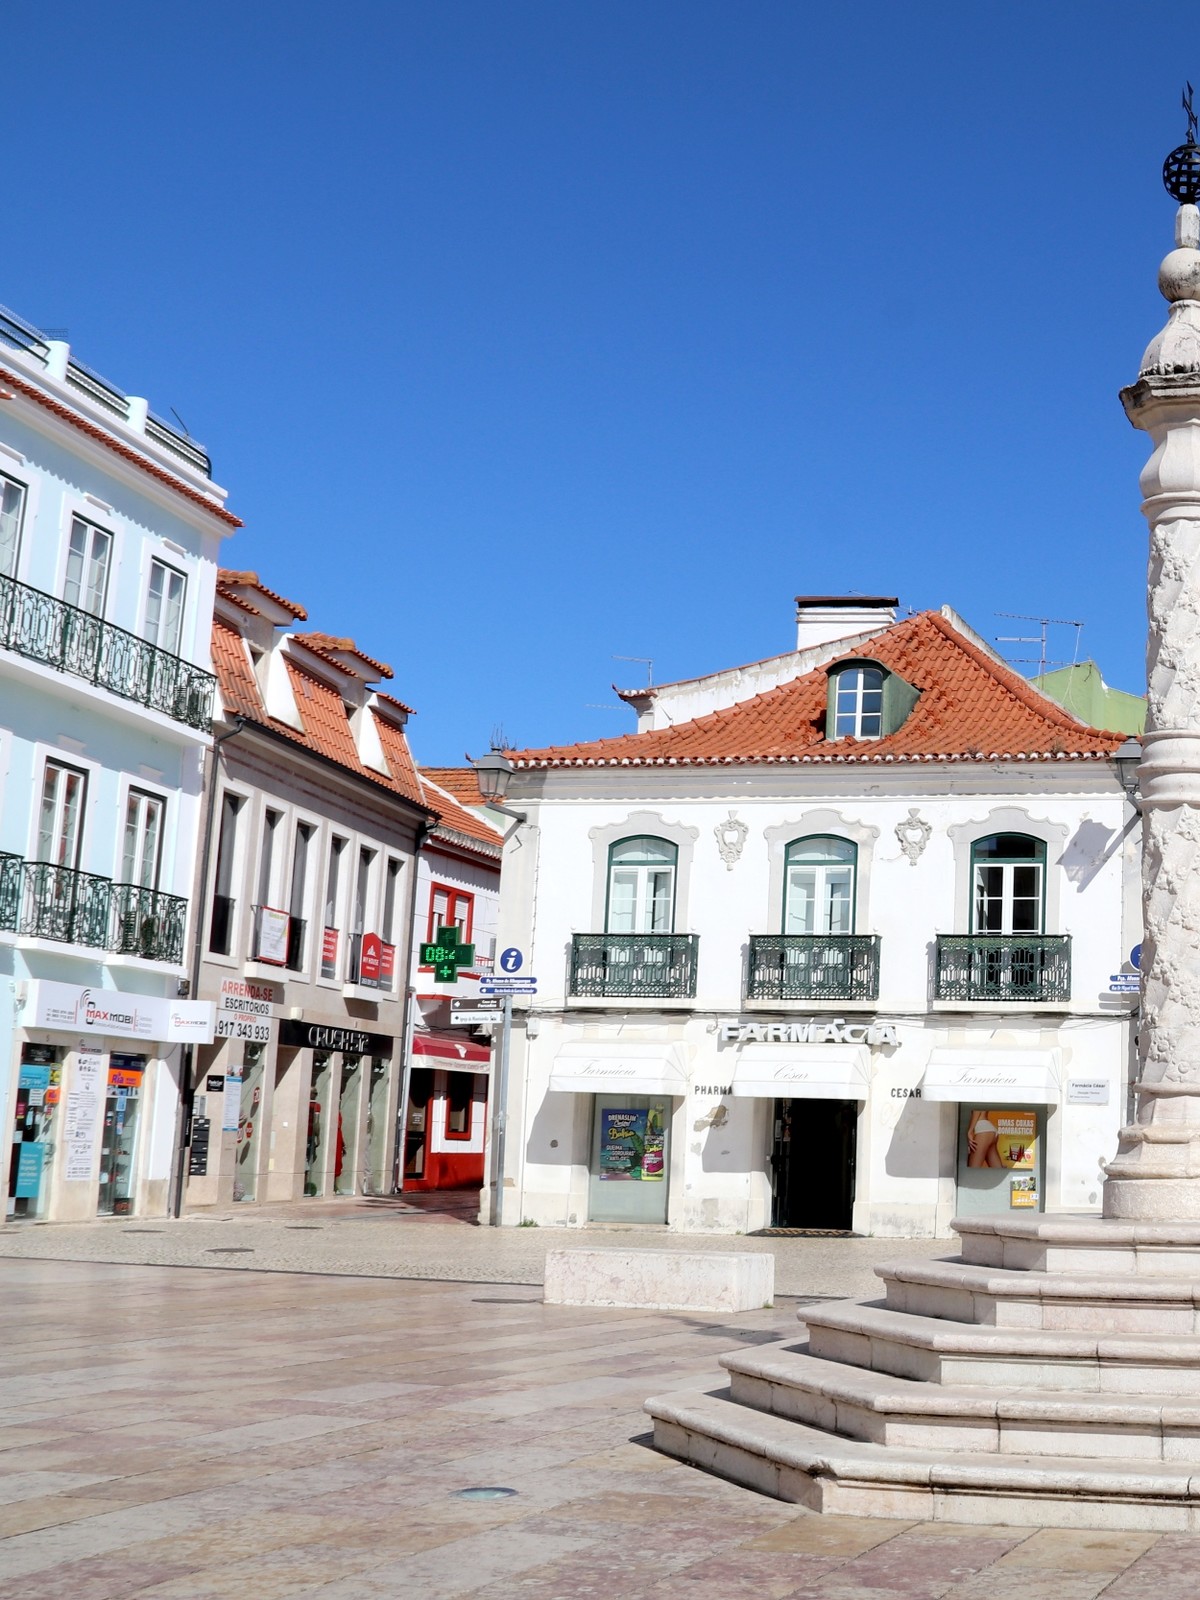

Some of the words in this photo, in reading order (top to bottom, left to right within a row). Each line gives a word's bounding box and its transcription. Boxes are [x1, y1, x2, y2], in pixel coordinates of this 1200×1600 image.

[222, 980, 273, 1002] ARRENDA-SE
[218, 1020, 235, 1036] 917
[237, 1023, 253, 1038] 343
[254, 1026, 270, 1041] 933
[721, 1018, 900, 1046] FARMÁCIA
[949, 1068, 1017, 1084] Farmácia
[694, 1085, 732, 1096] PHARMA
[891, 1088, 922, 1098] CESAR
[998, 1119, 1014, 1127] UMAS
[1016, 1120, 1034, 1128] COXAS
